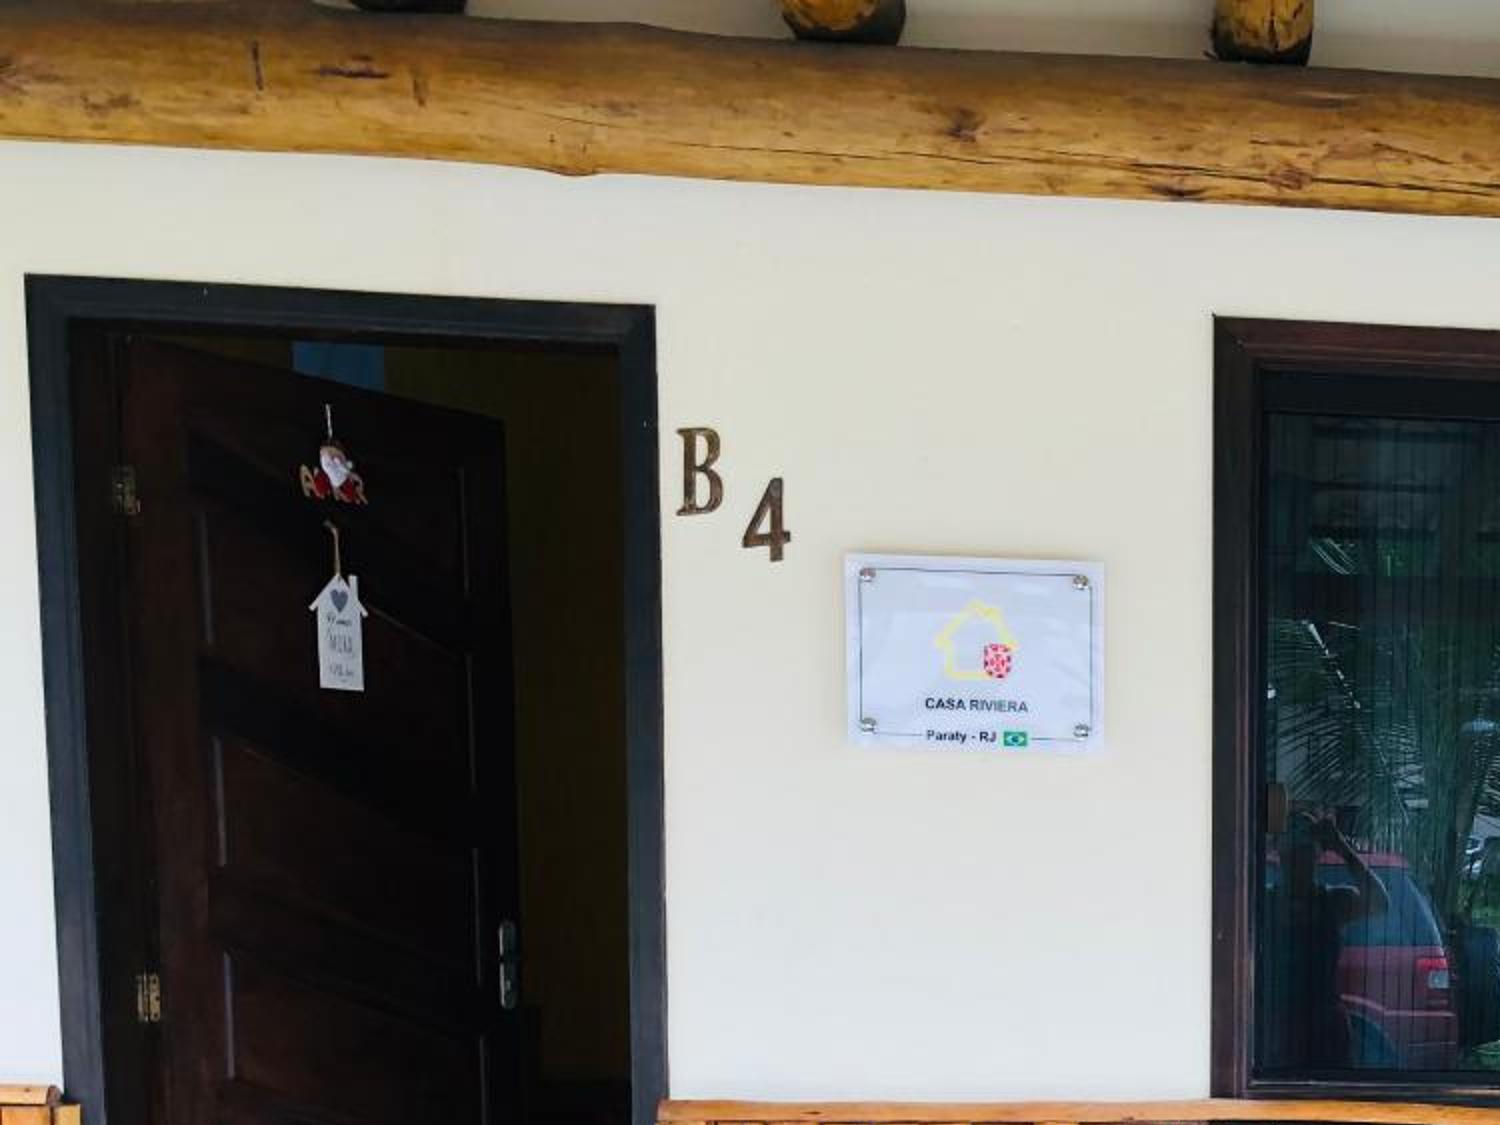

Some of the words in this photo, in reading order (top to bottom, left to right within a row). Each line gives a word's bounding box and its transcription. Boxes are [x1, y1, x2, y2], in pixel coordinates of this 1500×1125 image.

[675, 427, 724, 516] B
[742, 477, 791, 562] 4
[925, 697, 966, 711] CASA
[969, 699, 1028, 713] RIVIERA
[926, 729, 967, 744] Paraty
[979, 731, 997, 743] RJ
